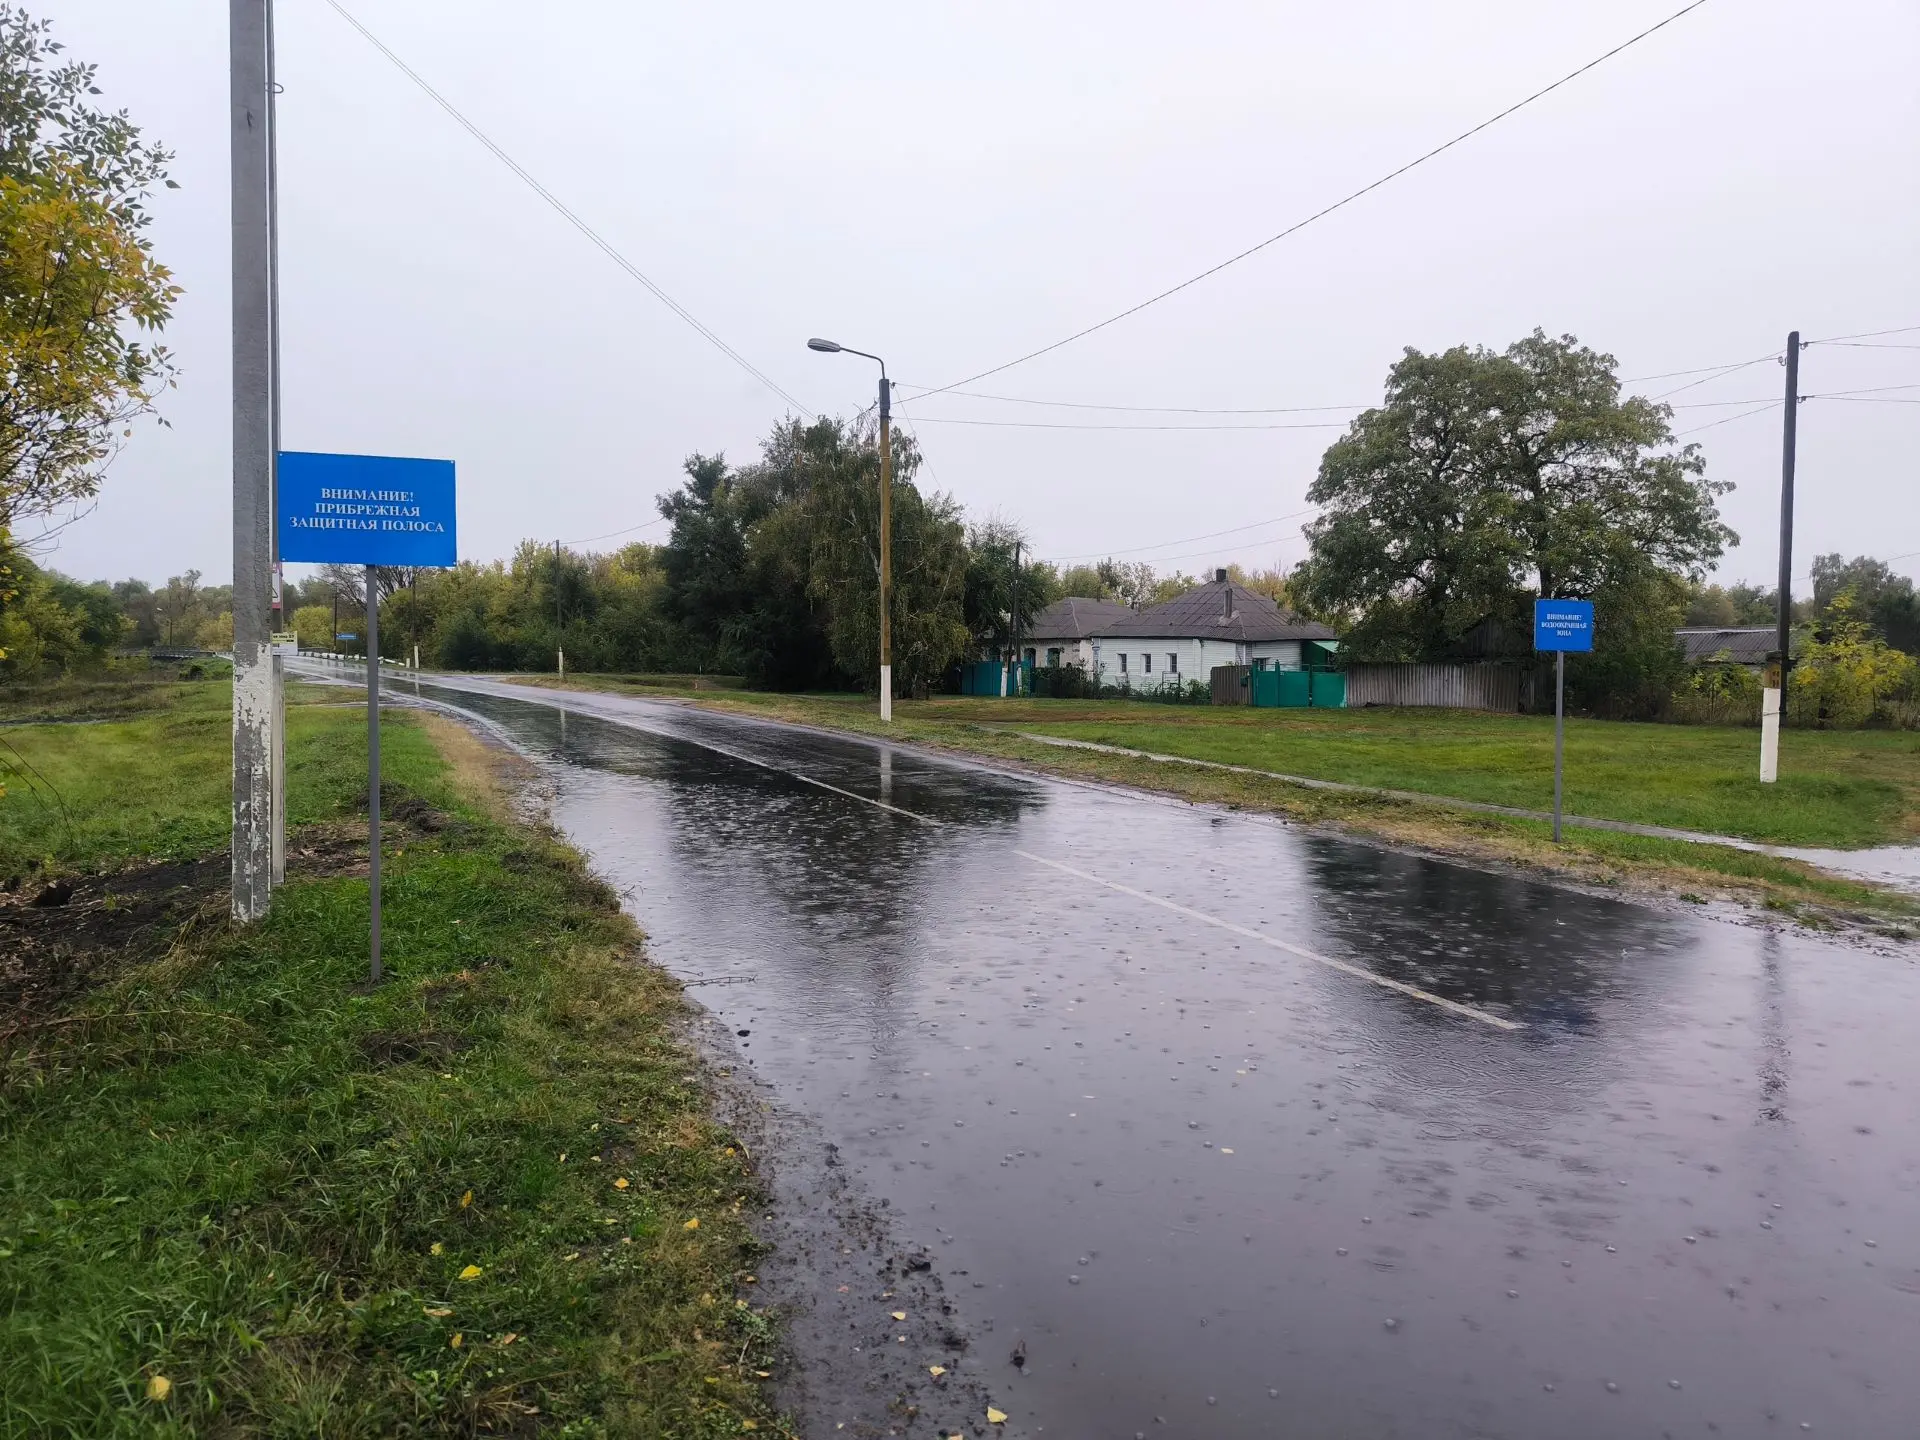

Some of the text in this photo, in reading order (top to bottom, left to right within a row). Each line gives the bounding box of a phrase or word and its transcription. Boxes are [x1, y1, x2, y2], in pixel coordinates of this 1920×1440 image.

[321, 487, 414, 502] ВНИМАНИЕ!
[315, 502, 420, 517] ПРИБРЕЖНАЯ
[289, 516, 445, 532] ЗАЩИТНАЯ ПОЛОСА
[1541, 621, 1588, 629] ВОДООХРАННАЯ
[1556, 629, 1572, 637] ЗОНА
